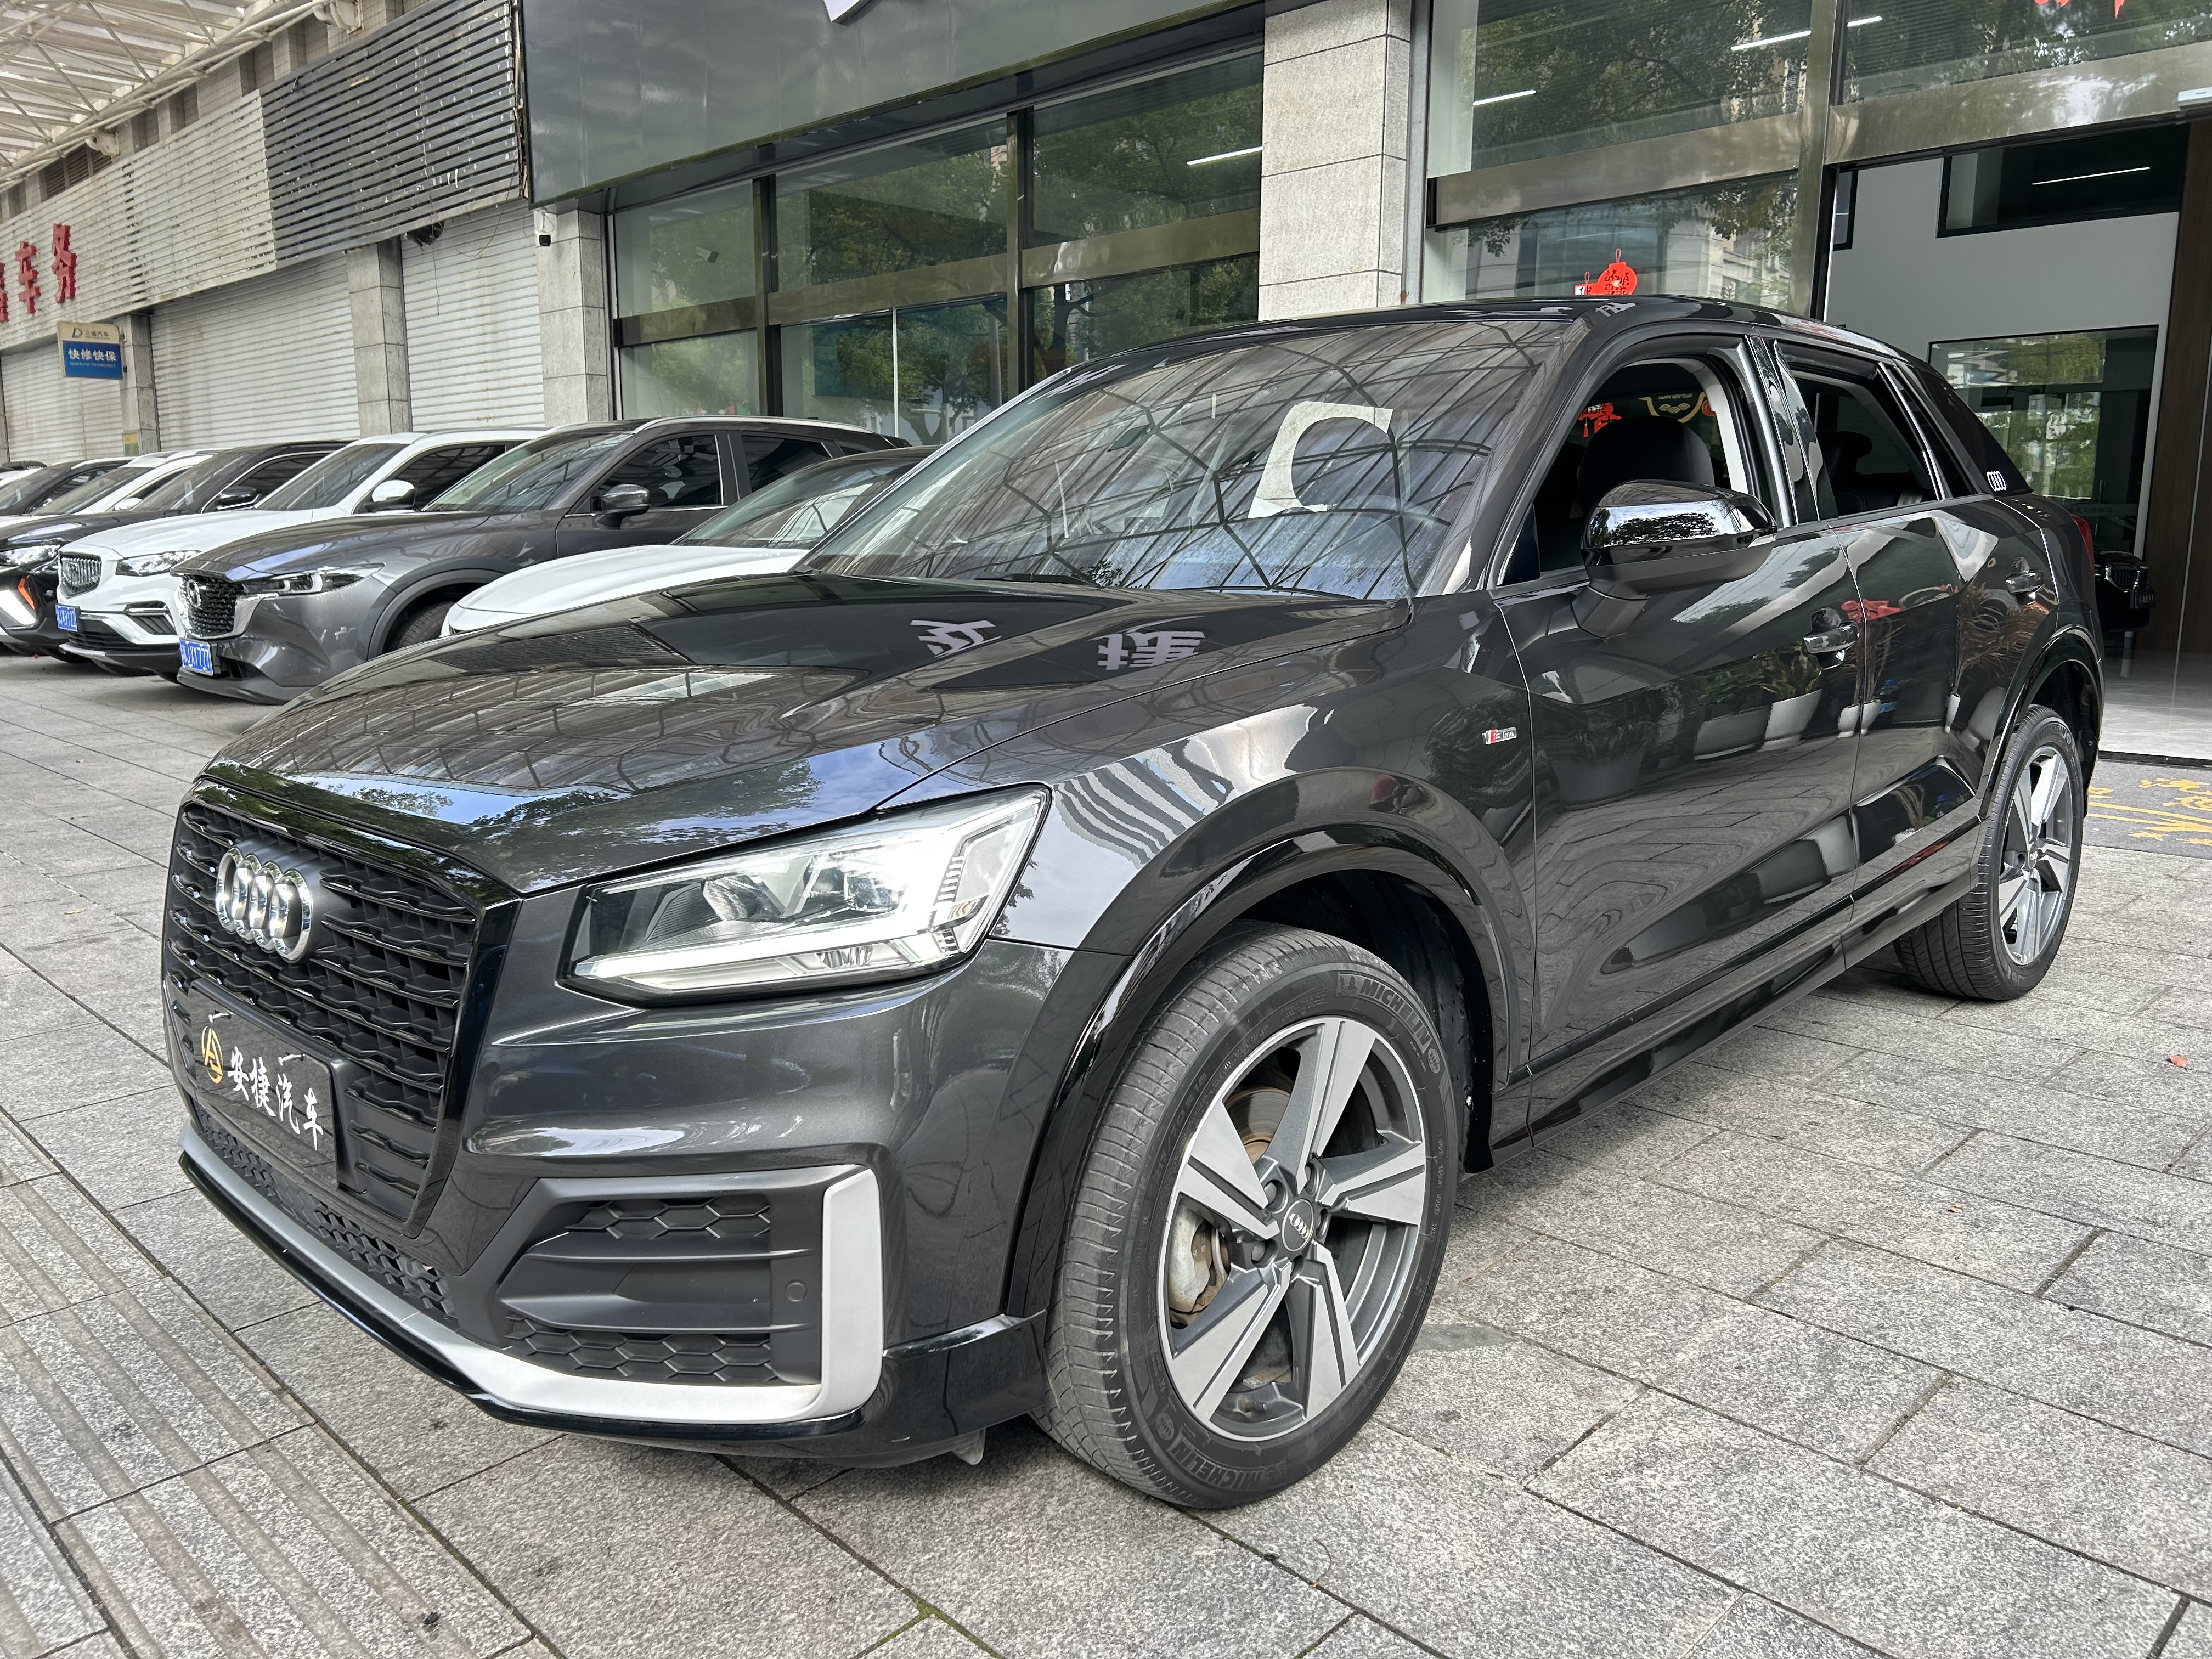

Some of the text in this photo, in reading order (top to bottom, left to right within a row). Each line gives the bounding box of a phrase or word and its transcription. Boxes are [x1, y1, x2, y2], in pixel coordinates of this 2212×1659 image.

[68, 348, 116, 362] 快修快保
[1359, 979, 1431, 1046] MICHELIN
[228, 1046, 324, 1151] 安捷汽车
[1173, 1438, 1261, 1490] MICHELIN
